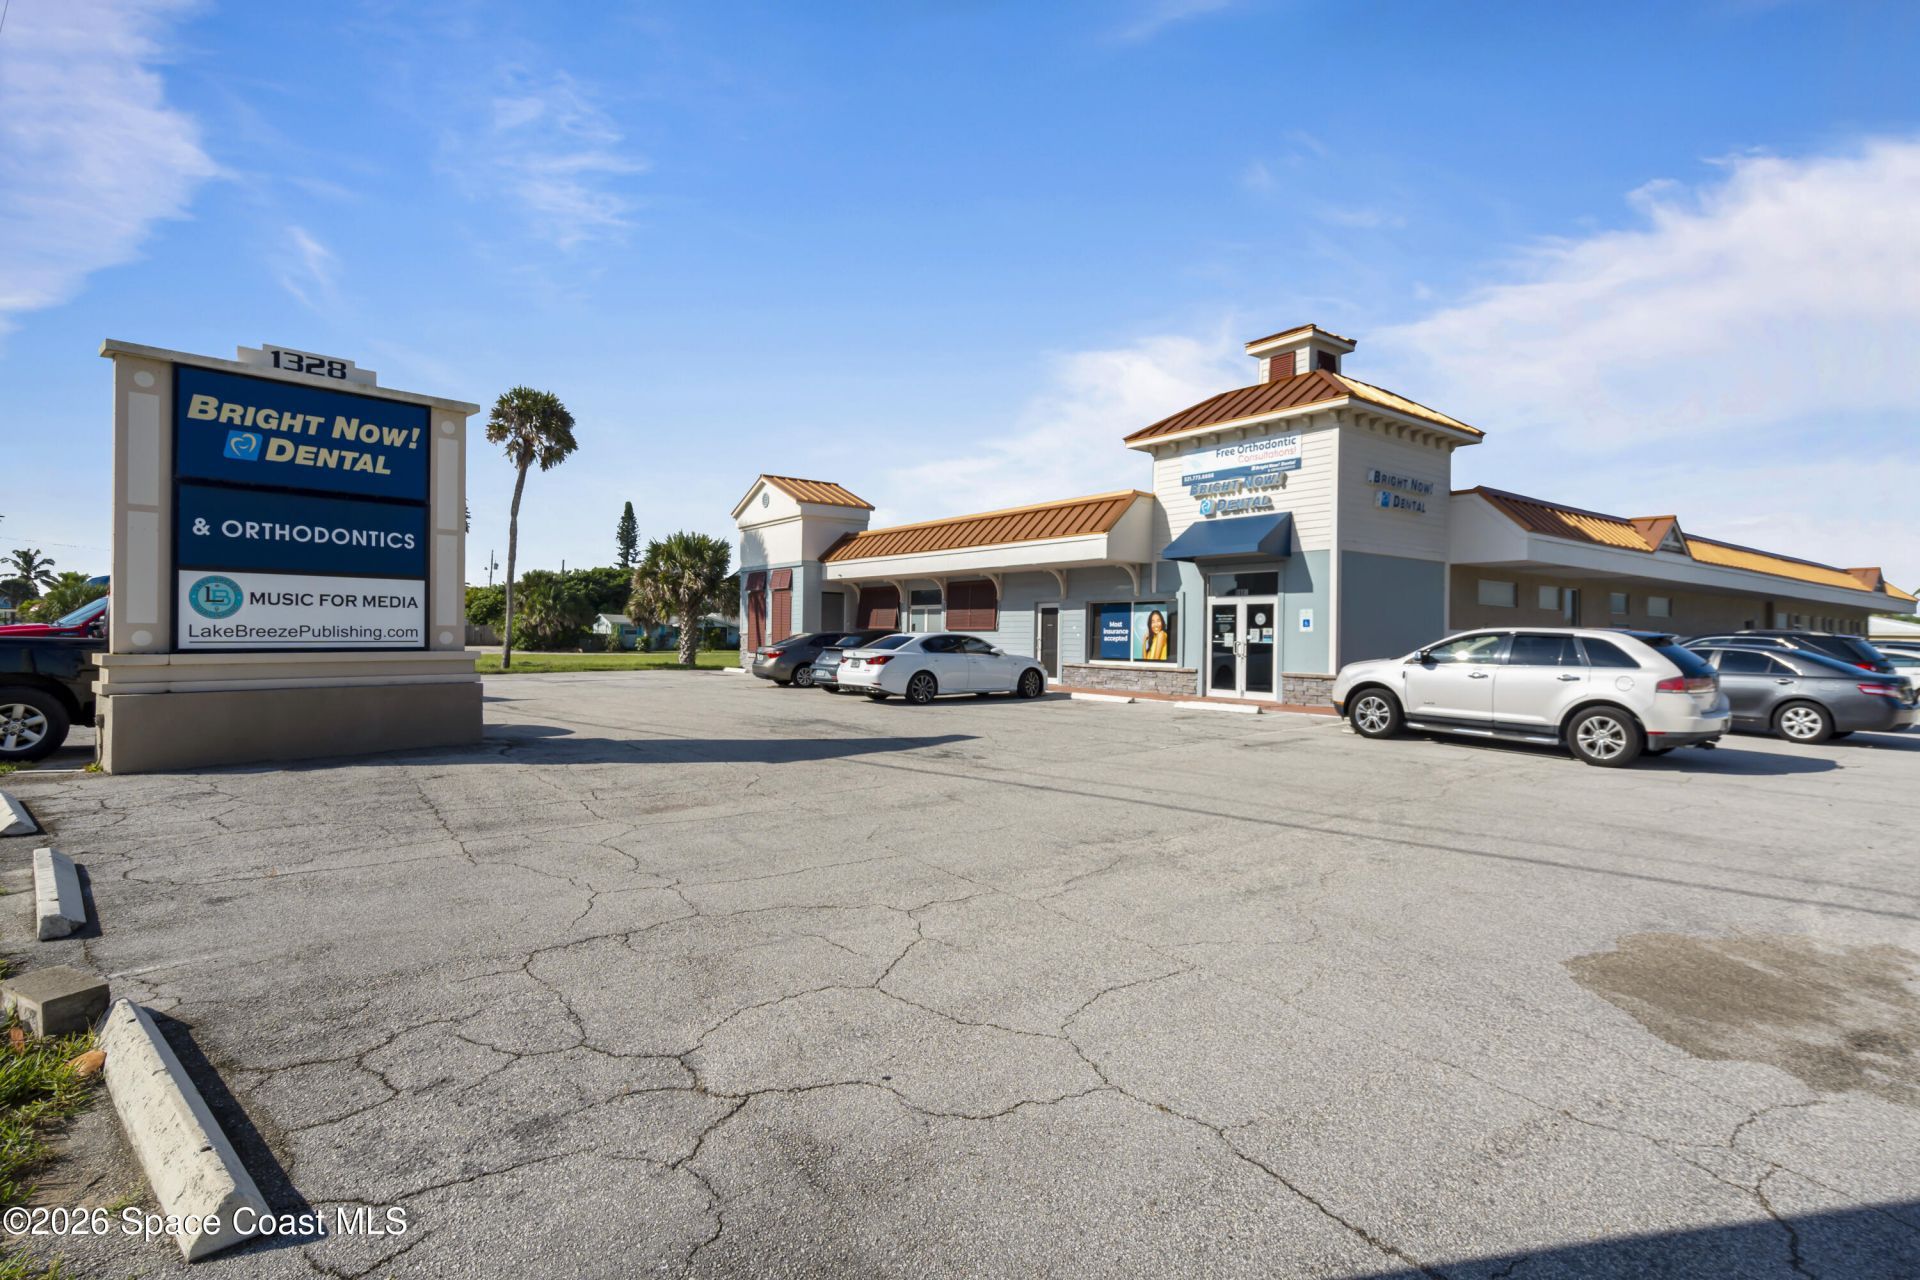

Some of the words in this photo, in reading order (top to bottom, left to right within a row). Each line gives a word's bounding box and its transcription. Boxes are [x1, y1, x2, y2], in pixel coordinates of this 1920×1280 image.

[270, 349, 347, 380] 1328
[186, 393, 325, 437] BRIGHT
[331, 415, 421, 450] NOW!
[264, 436, 392, 476] DENTAL
[1215, 448, 1235, 458] Free
[1237, 436, 1297, 454] Orthodontic
[1238, 446, 1297, 463] Consultations!
[1216, 495, 1273, 512] DENTAL
[1393, 495, 1426, 513] DENTAL
[192, 517, 210, 536] &
[221, 519, 416, 549] ORTHODONTICS
[249, 591, 315, 607] MUSIC
[319, 594, 358, 607] FOR
[362, 595, 419, 609] MEDIA
[188, 624, 419, 641] LakeBreezePublishing.com
